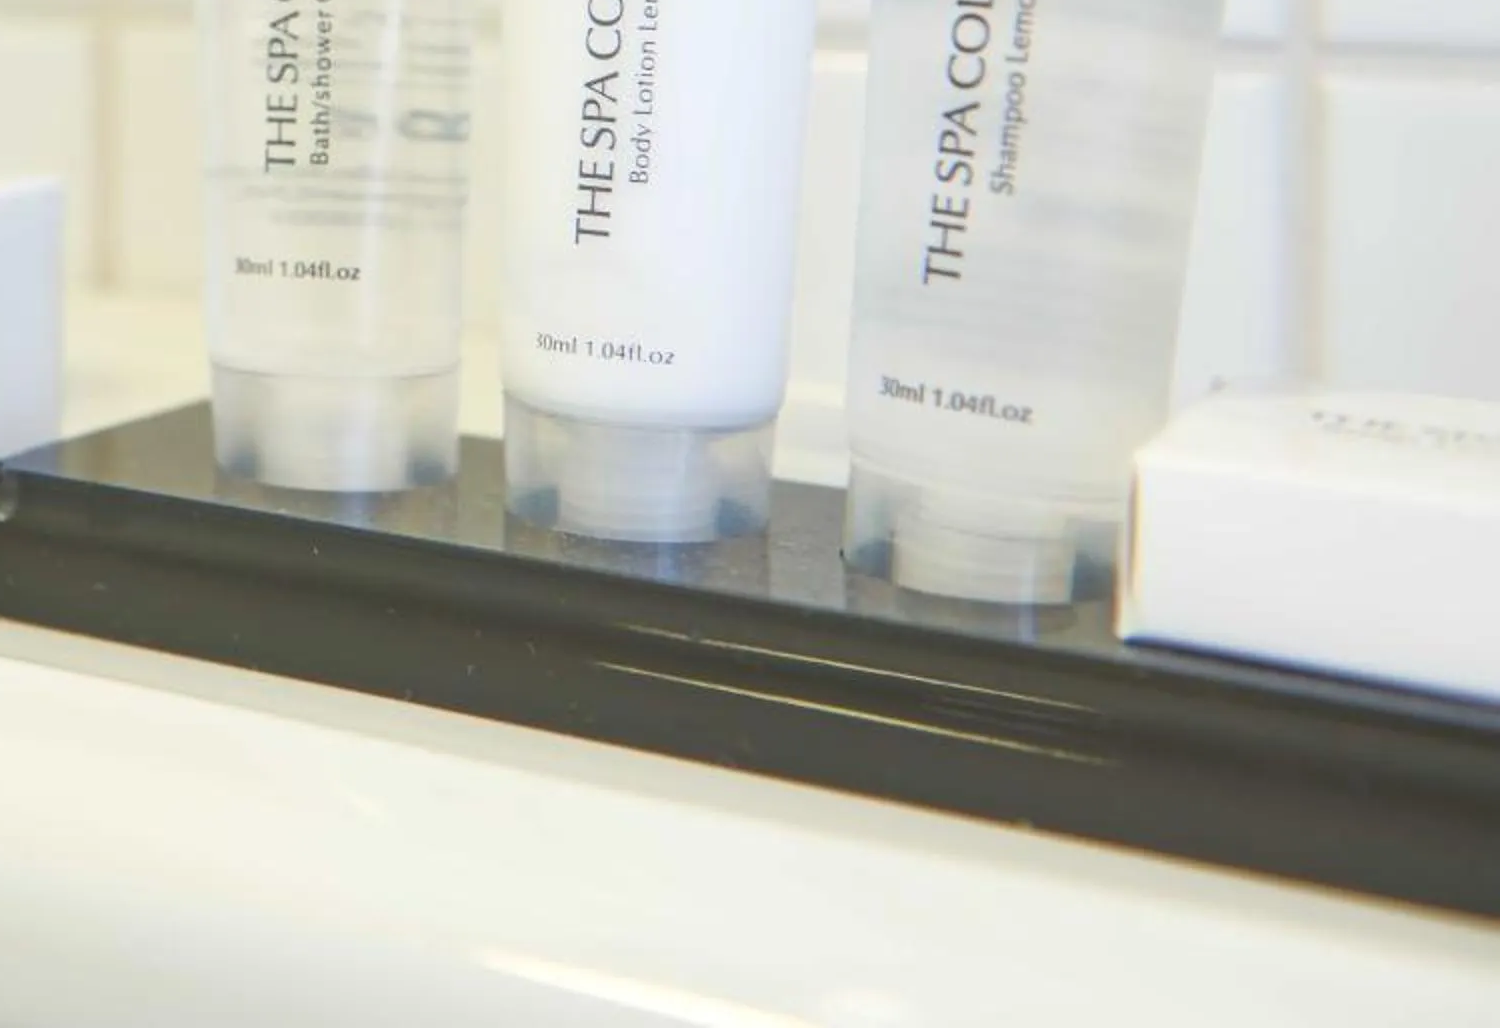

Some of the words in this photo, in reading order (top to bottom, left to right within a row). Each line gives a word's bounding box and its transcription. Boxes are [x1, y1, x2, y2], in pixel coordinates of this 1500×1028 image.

[267, 9, 301, 84] SPA
[633, 40, 657, 115] Lotion
[309, 8, 334, 166] Bath/shower
[580, 70, 621, 152] SPA
[265, 93, 299, 172] THE
[628, 122, 653, 185] Body
[934, 99, 982, 188] SPA
[988, 71, 1030, 197] Shampoo
[575, 159, 614, 245] THE
[922, 193, 971, 286] THE
[535, 331, 578, 354] 30ml
[878, 374, 925, 405] 30ml
